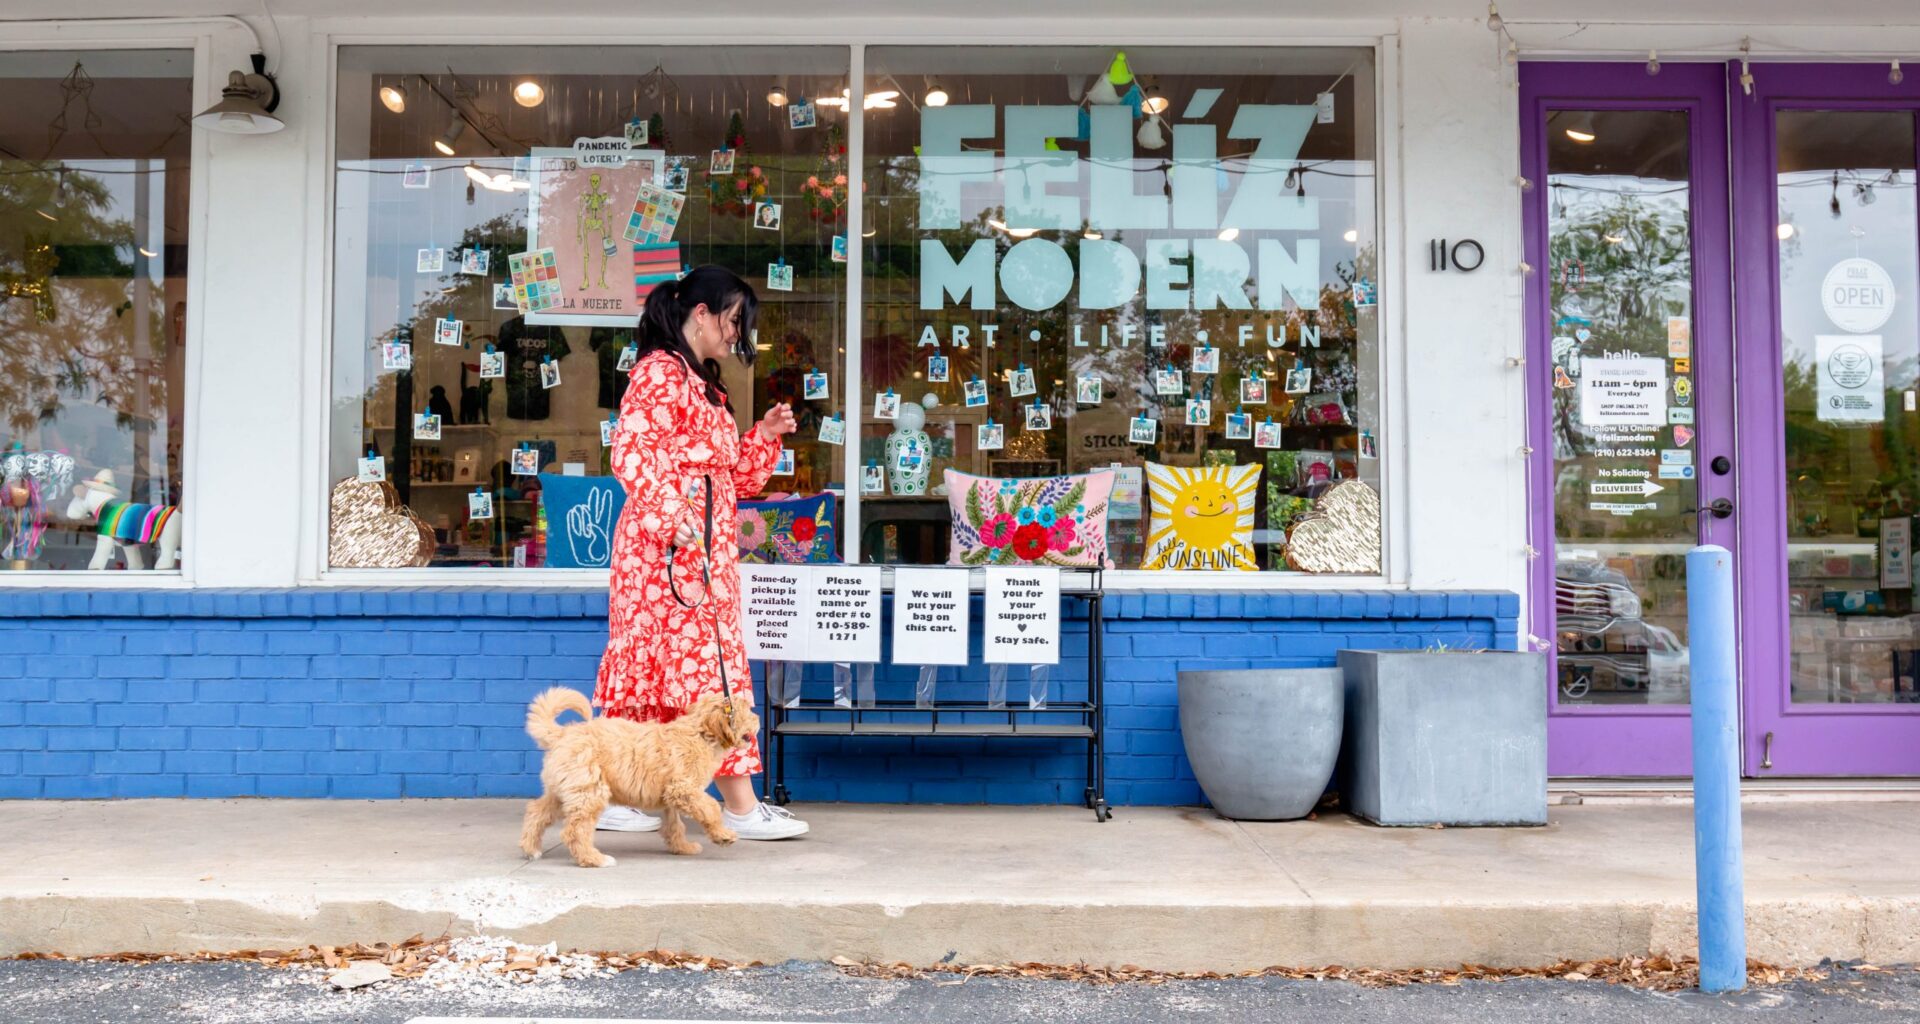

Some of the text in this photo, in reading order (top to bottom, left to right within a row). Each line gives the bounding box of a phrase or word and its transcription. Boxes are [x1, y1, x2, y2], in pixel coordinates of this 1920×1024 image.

[578, 142, 627, 151] PANDEMIC
[583, 155, 622, 164] LOTERIA
[1431, 238, 1484, 272] 110
[920, 238, 1320, 310] MODERN
[1833, 287, 1884, 306] OPEN
[563, 297, 622, 310] LA MUERTE
[918, 325, 1320, 348] ART LIFE FUN
[516, 338, 547, 348] TACOS
[1592, 380, 1620, 388] 11am
[1632, 380, 1657, 389] 6pm
[1679, 412, 1690, 420] Pay
[1590, 424, 1616, 432] Follow
[1618, 424, 1629, 432] Us
[1084, 434, 1138, 448] STICK
[1594, 448, 1656, 458] (210) 622-8364
[1598, 468, 1611, 477] No
[1612, 468, 1652, 479] Soliciting.
[1156, 536, 1184, 555] hello
[1158, 542, 1248, 570] SUNSHINE!
[751, 574, 798, 585] Same-day
[826, 576, 862, 585] Please
[1006, 578, 1040, 587] Thank
[751, 585, 797, 596] pickup is
[817, 588, 871, 597] text your
[912, 590, 952, 599] We will
[1002, 590, 1043, 598] you for
[751, 597, 796, 606] available
[1009, 601, 1036, 609] your
[907, 602, 956, 611] put your
[748, 607, 798, 617] for orders
[815, 610, 848, 619] order
[998, 612, 1046, 621] support!
[913, 613, 933, 622] bag
[756, 619, 789, 628] placed
[817, 621, 870, 630] 210-589-
[905, 624, 927, 632] this
[756, 630, 788, 639] before
[829, 632, 857, 641] 1271
[994, 636, 1049, 645] Stay safe.
[759, 641, 783, 650] 9am.
